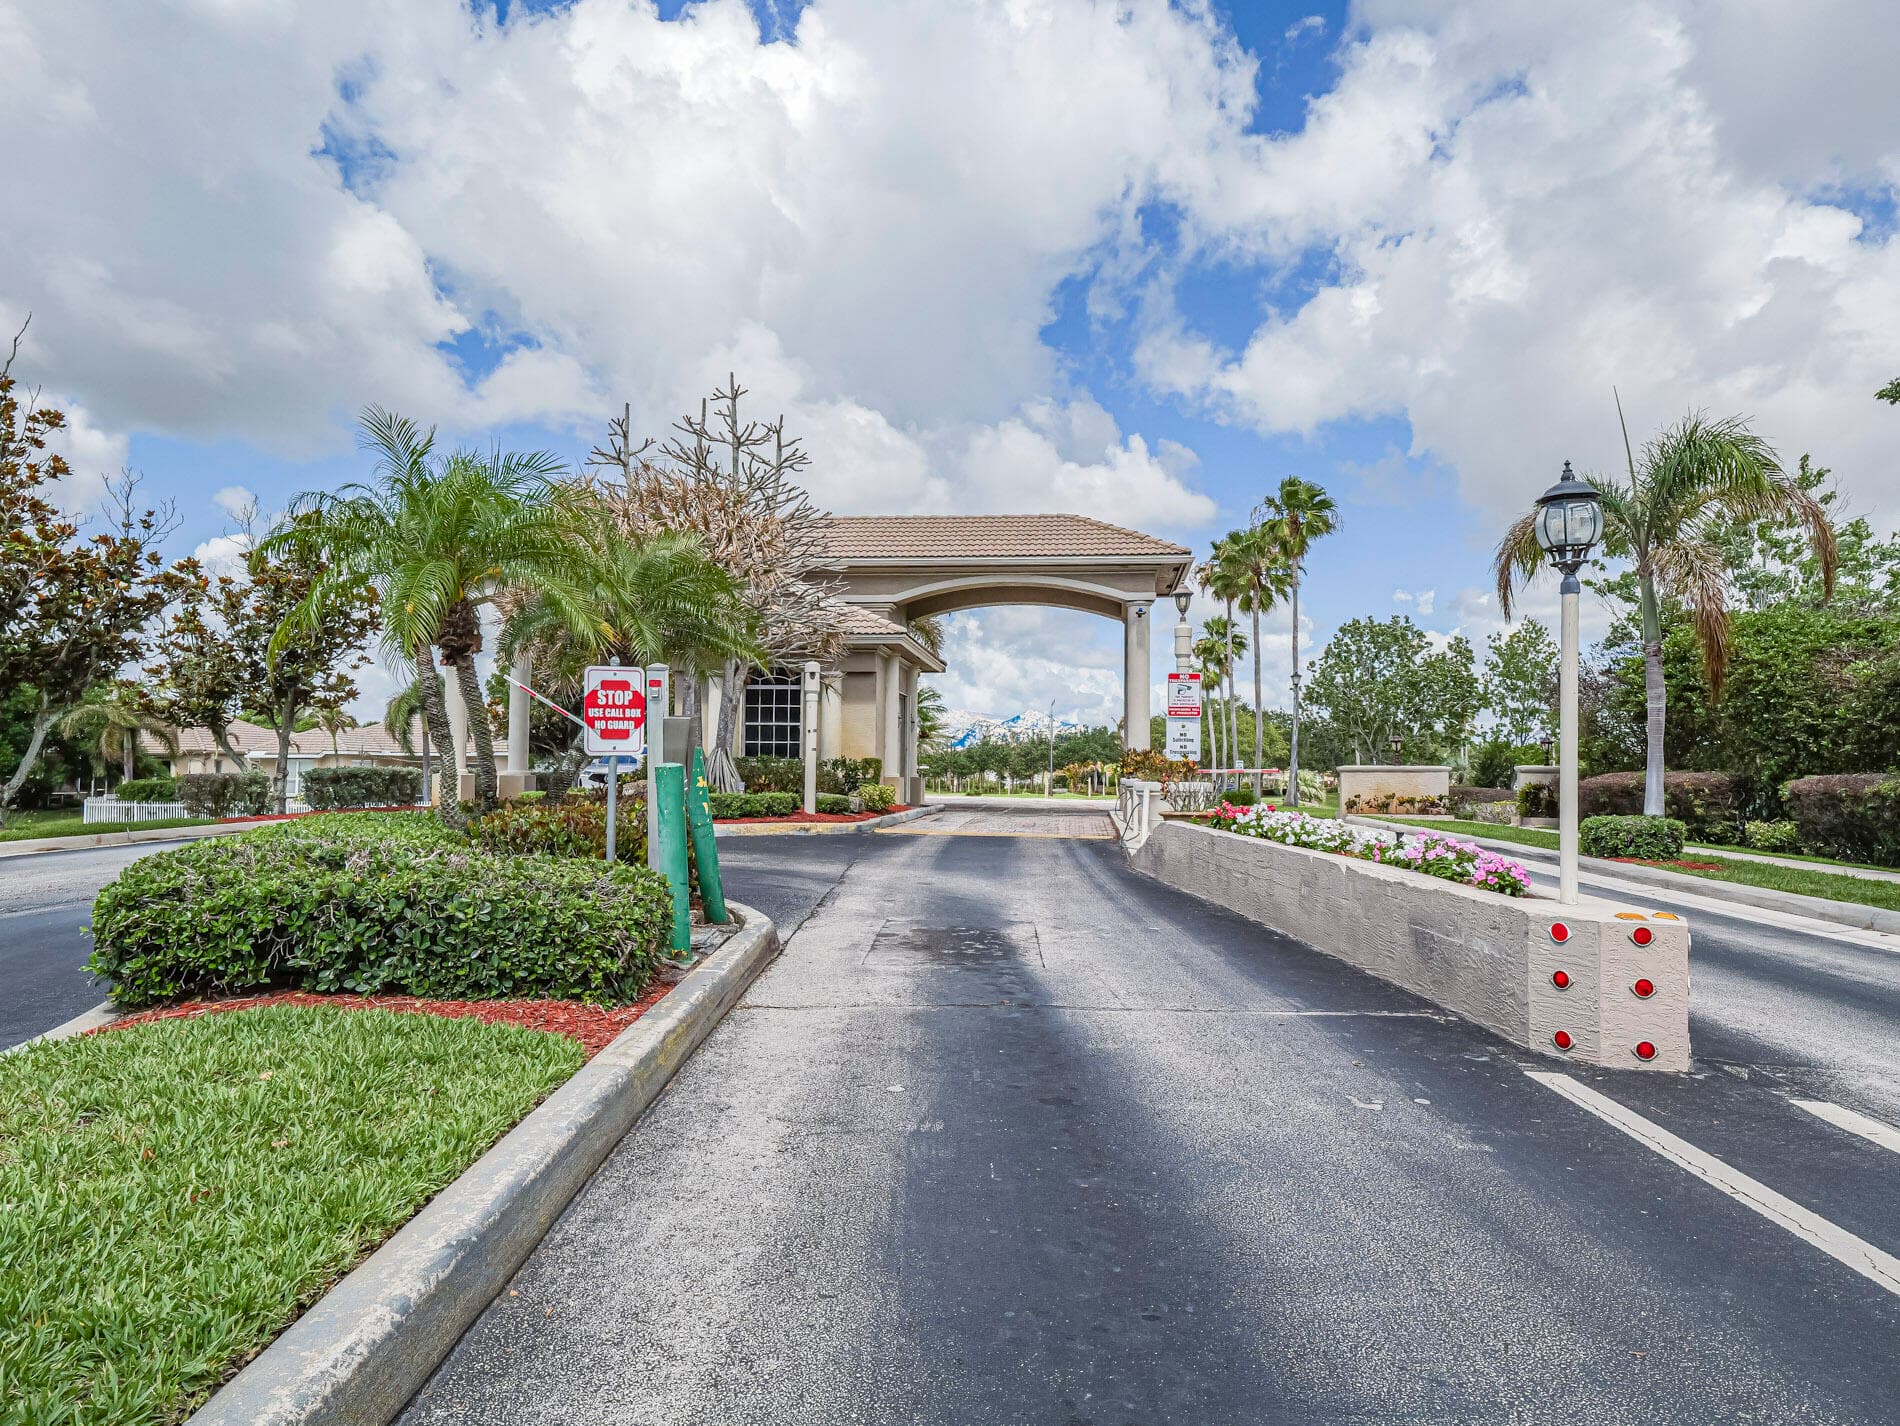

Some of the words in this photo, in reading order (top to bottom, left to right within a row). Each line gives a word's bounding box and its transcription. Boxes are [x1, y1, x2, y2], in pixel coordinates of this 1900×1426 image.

[597, 689, 633, 706] STOP
[588, 707, 604, 718] USE
[605, 707, 624, 718] CALL
[625, 707, 642, 718] BOX
[594, 720, 606, 730] NO
[607, 720, 635, 730] GUARD
